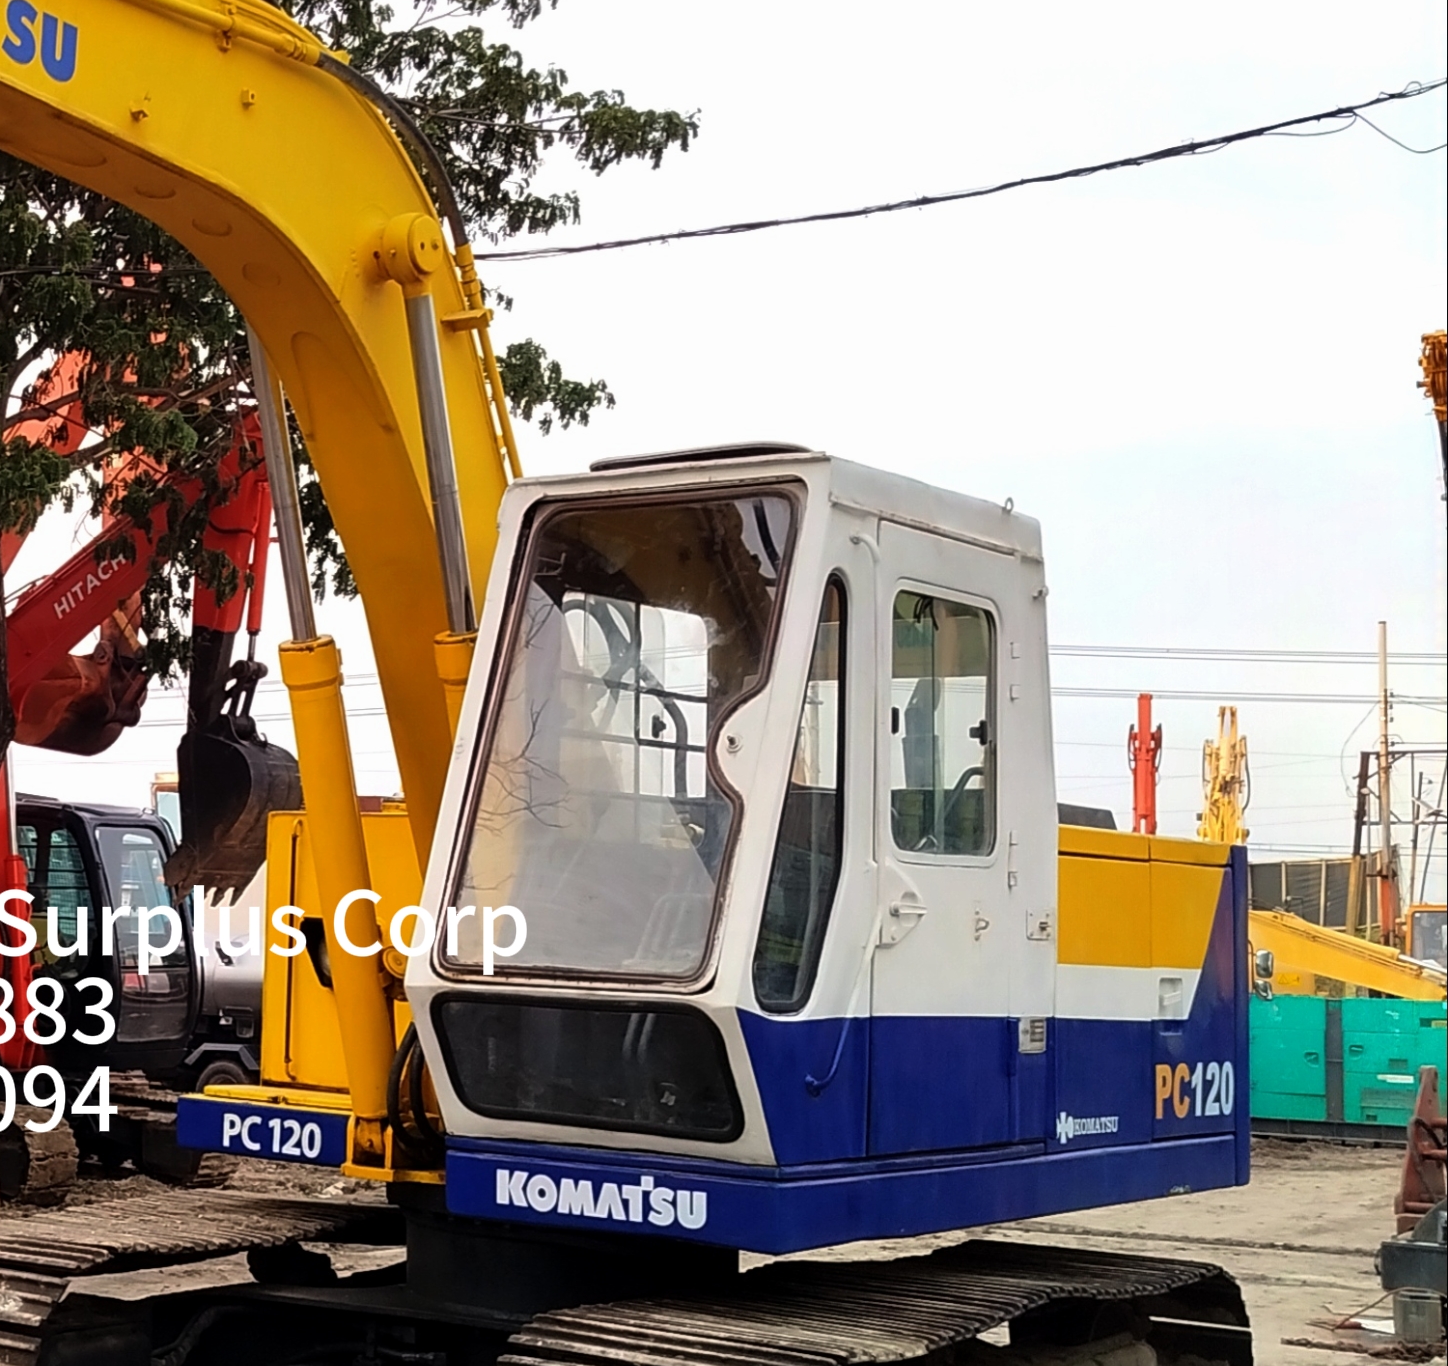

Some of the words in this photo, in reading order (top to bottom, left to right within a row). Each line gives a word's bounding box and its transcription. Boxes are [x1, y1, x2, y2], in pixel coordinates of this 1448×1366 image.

[53, 553, 127, 620] HITACH
[1155, 1061, 1234, 1120] PC120
[222, 1113, 262, 1151] PC
[268, 1117, 322, 1158] 120
[1072, 1116, 1119, 1134] KOMATSU
[496, 1168, 707, 1229] KOMATSU
